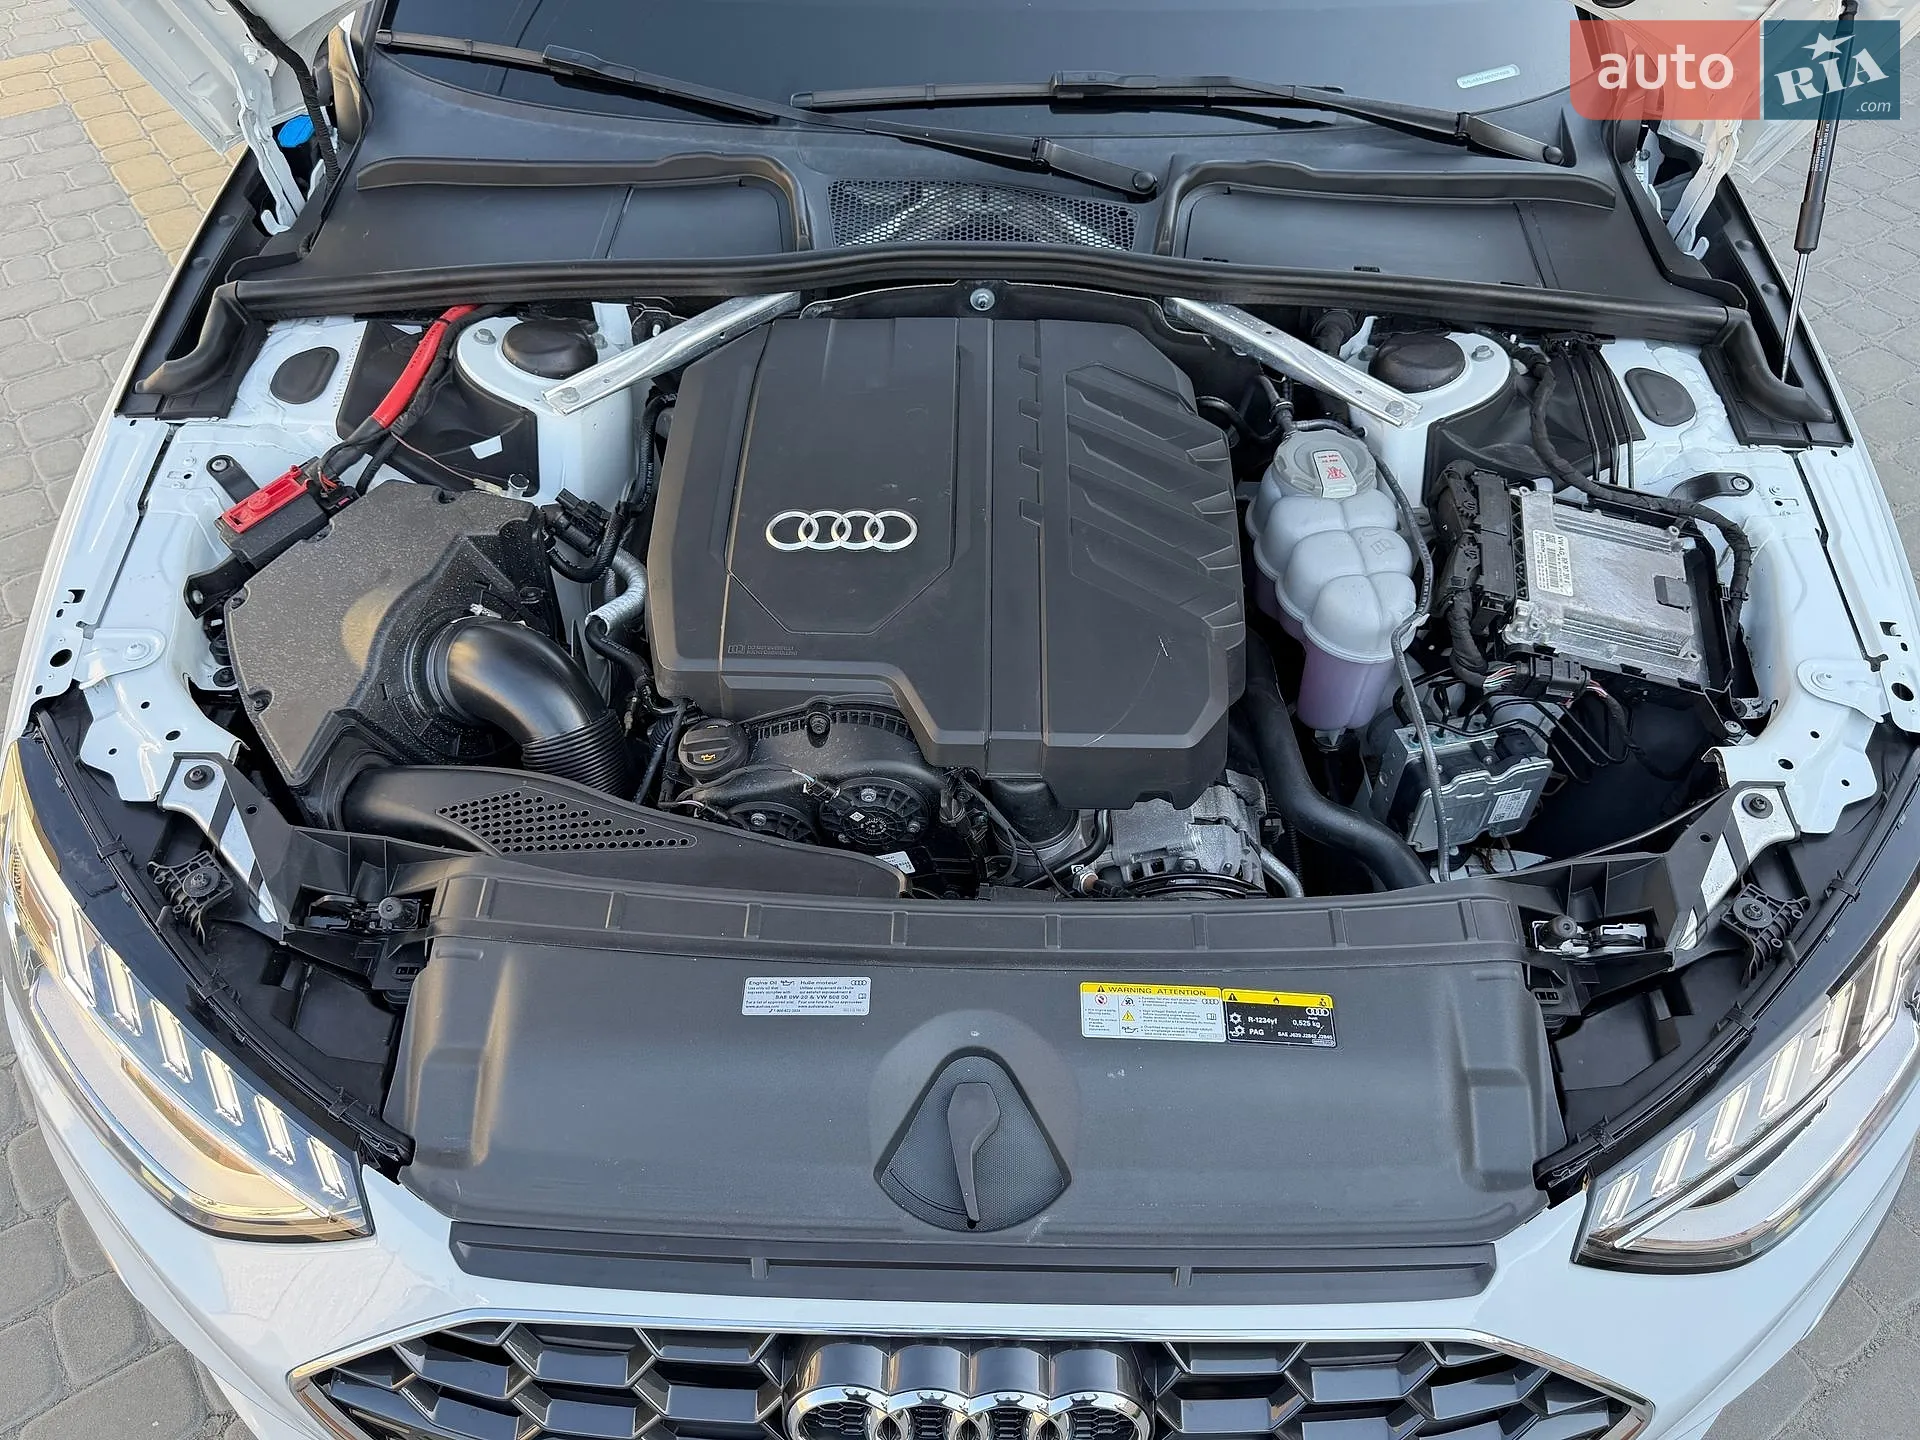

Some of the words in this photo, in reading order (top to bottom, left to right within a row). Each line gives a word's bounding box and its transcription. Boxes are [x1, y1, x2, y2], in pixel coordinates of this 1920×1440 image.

[1108, 986, 1152, 994] WARNING
[1157, 988, 1207, 996] ATTENTION
[1247, 1017, 1278, 1025] R-1234yf
[1312, 1020, 1321, 1028] kg
